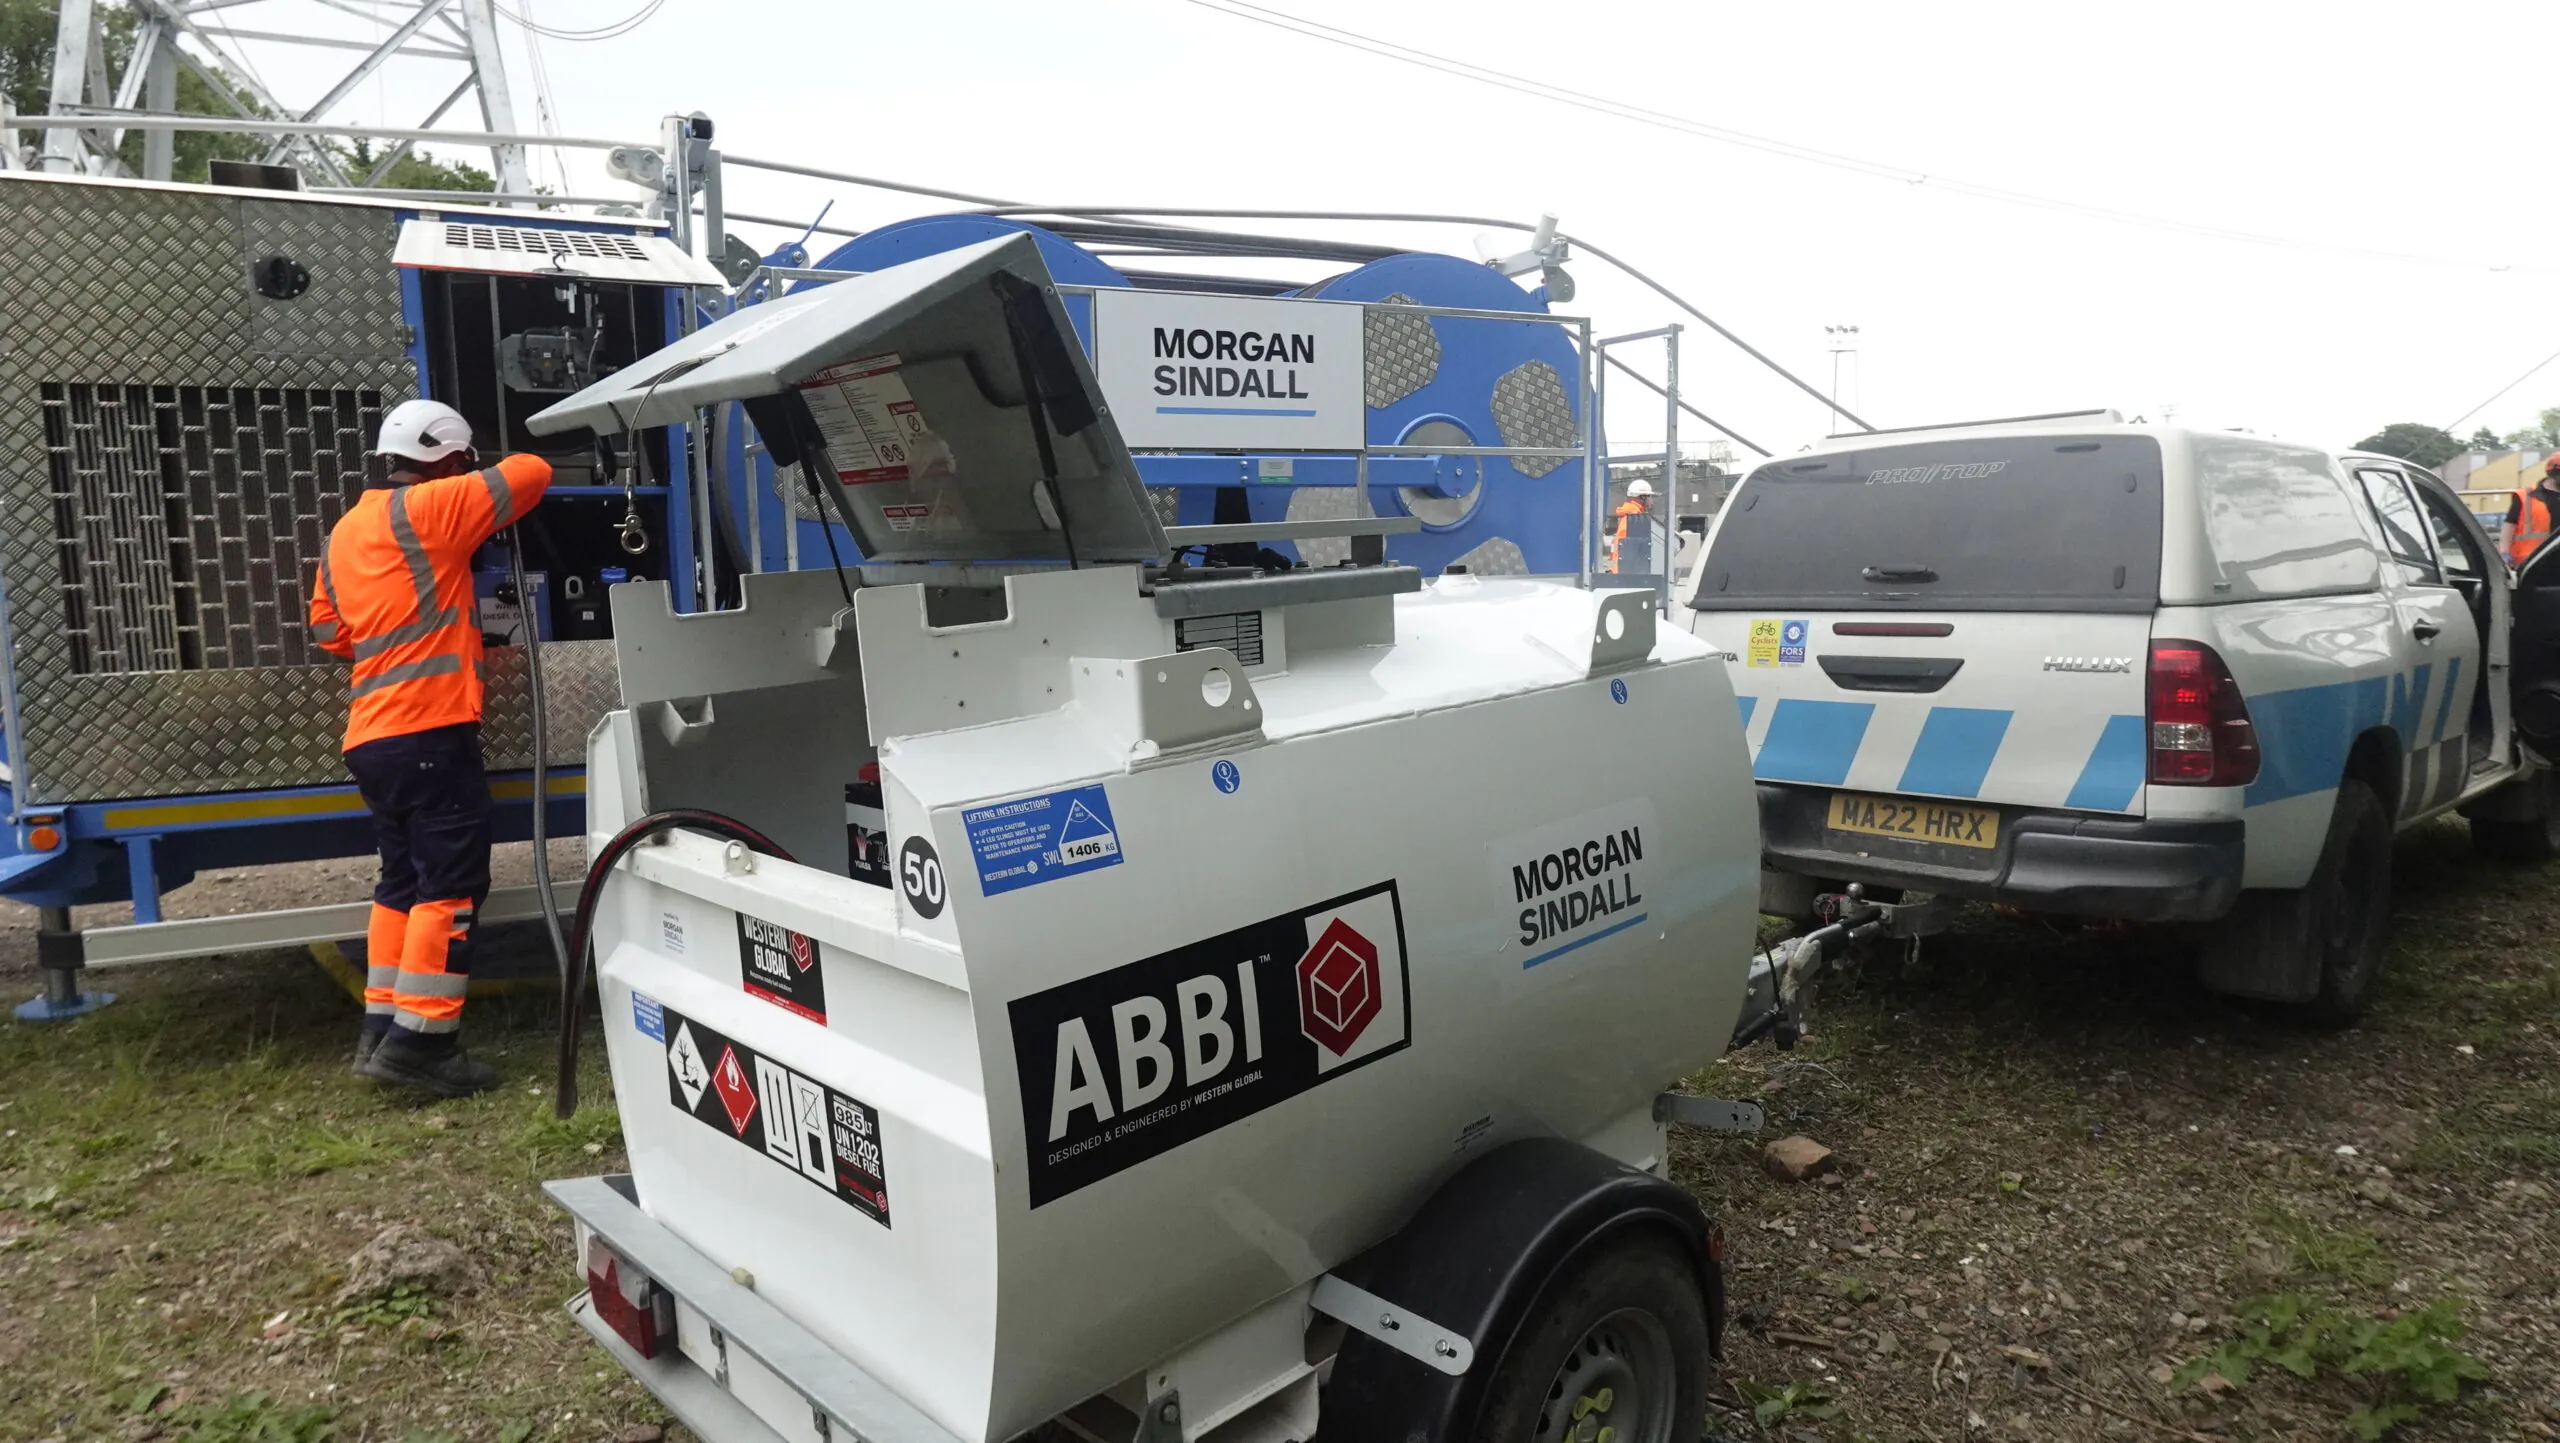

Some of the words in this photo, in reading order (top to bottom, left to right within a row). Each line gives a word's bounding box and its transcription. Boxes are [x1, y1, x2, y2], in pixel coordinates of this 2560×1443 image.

[1154, 327, 1314, 363] MORGAN
[1153, 365, 1309, 399] SINDALL
[1781, 647, 1804, 656] FORS
[2043, 656, 2133, 673] HILUX
[966, 809, 995, 823] LIFTING
[996, 798, 1051, 817] INSTRUCTIONS
[1841, 797, 1918, 834] MA22
[1924, 807, 1986, 842] HRX
[983, 844, 1000, 852] REFER
[1007, 835, 1035, 847] OPERATORS
[1036, 832, 1047, 840] AND
[986, 836, 996, 844] LEG
[996, 832, 1014, 841] SLINGS
[1015, 829, 1029, 837] MUST
[1037, 823, 1051, 832] USED
[990, 826, 1005, 835] WITH
[1004, 821, 1027, 831] CAUTION
[855, 859, 872, 871] YUASA
[985, 847, 1021, 860] MAINTENANCE
[1022, 842, 1043, 852] MANUAL
[1042, 850, 1062, 867] SWL
[1067, 842, 1101, 859] 1406
[1104, 842, 1115, 852] KG
[1512, 826, 1643, 904] MORGAN
[905, 851, 942, 905] 50
[984, 869, 1008, 882] WESTERN
[1008, 864, 1028, 876] GLOBAL
[1519, 872, 1642, 947] SINDALL
[742, 914, 788, 953] WESTERN
[754, 944, 791, 981] GLOBAL
[1048, 960, 1263, 1142] ABBI
[836, 1105, 864, 1131] 985
[864, 1120, 873, 1135] LT
[1048, 1135, 1102, 1166] DESIGNED
[1104, 1131, 1113, 1143] &
[1114, 1104, 1178, 1138] ENGINEERED
[1180, 1097, 1192, 1112] BY
[1193, 1081, 1233, 1105] WESTERN
[1234, 1070, 1264, 1089] GLOBAL
[833, 1123, 880, 1165] UN1202
[836, 1143, 862, 1169] DIESEL
[863, 1160, 881, 1180] FUEL
